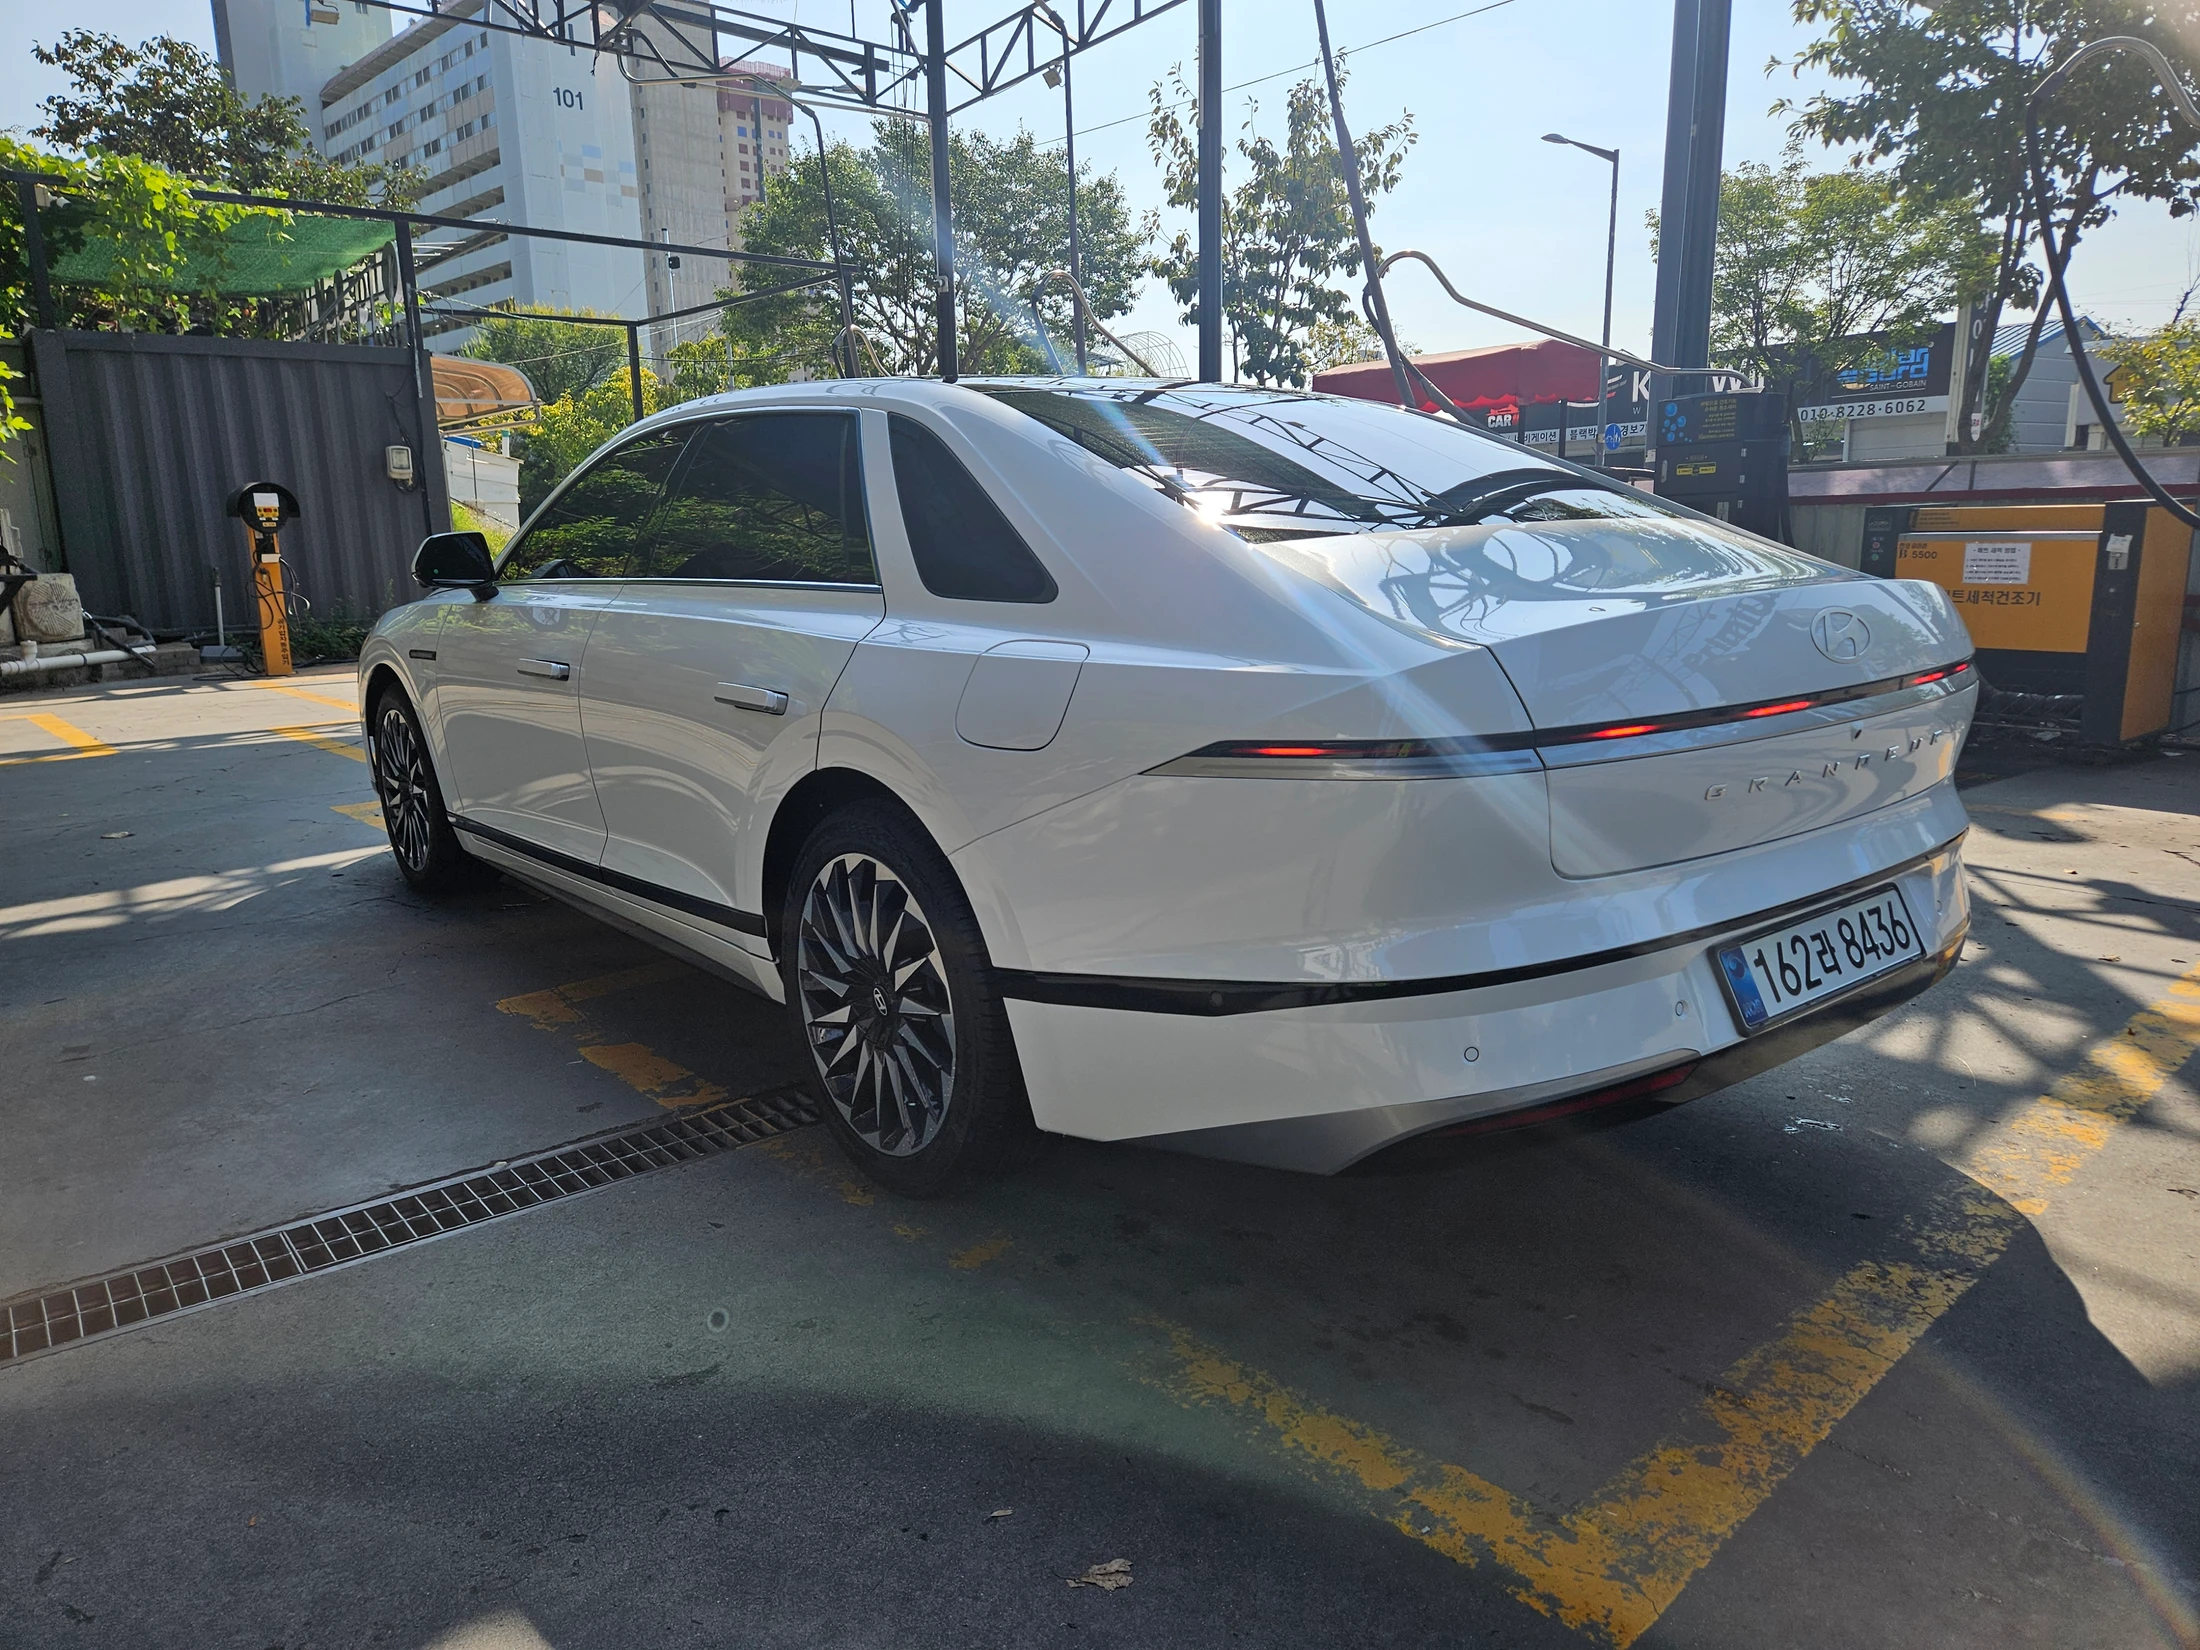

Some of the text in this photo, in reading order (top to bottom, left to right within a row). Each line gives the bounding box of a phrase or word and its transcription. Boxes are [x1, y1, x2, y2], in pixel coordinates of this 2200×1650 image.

[553, 87, 583, 110] 101
[1570, 427, 1597, 440] 블랙박
[1912, 550, 1938, 559] 5500
[1945, 589, 2042, 606] 트세척건조기
[1753, 900, 1911, 1004] 162라 8436
